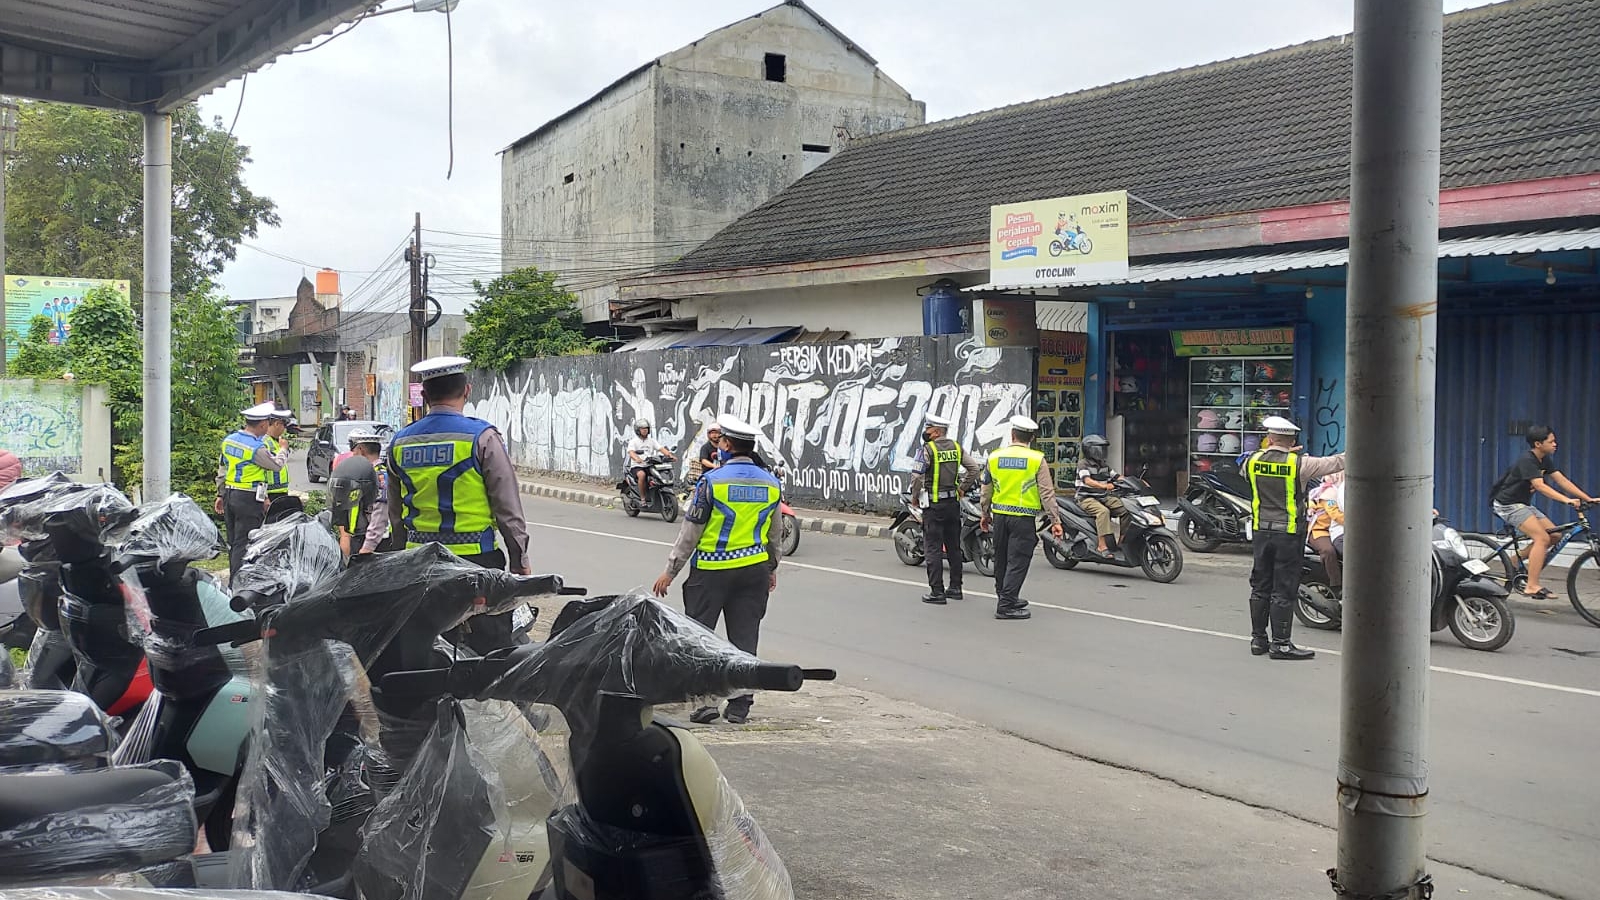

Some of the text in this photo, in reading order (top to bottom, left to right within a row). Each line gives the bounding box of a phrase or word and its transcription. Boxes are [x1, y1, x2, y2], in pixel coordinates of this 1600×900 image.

[1081, 201, 1119, 216] maxim
[1007, 213, 1031, 225] Pesan
[998, 223, 1041, 239] perjalanan
[1007, 235, 1031, 248] cepat
[1035, 266, 1076, 279] OTOCLINK
[827, 343, 873, 375] KEDIRI
[403, 447, 451, 464] POLISI
[998, 458, 1026, 469] POLISI
[1253, 463, 1292, 476] POLISI
[729, 487, 768, 501] POLISI
